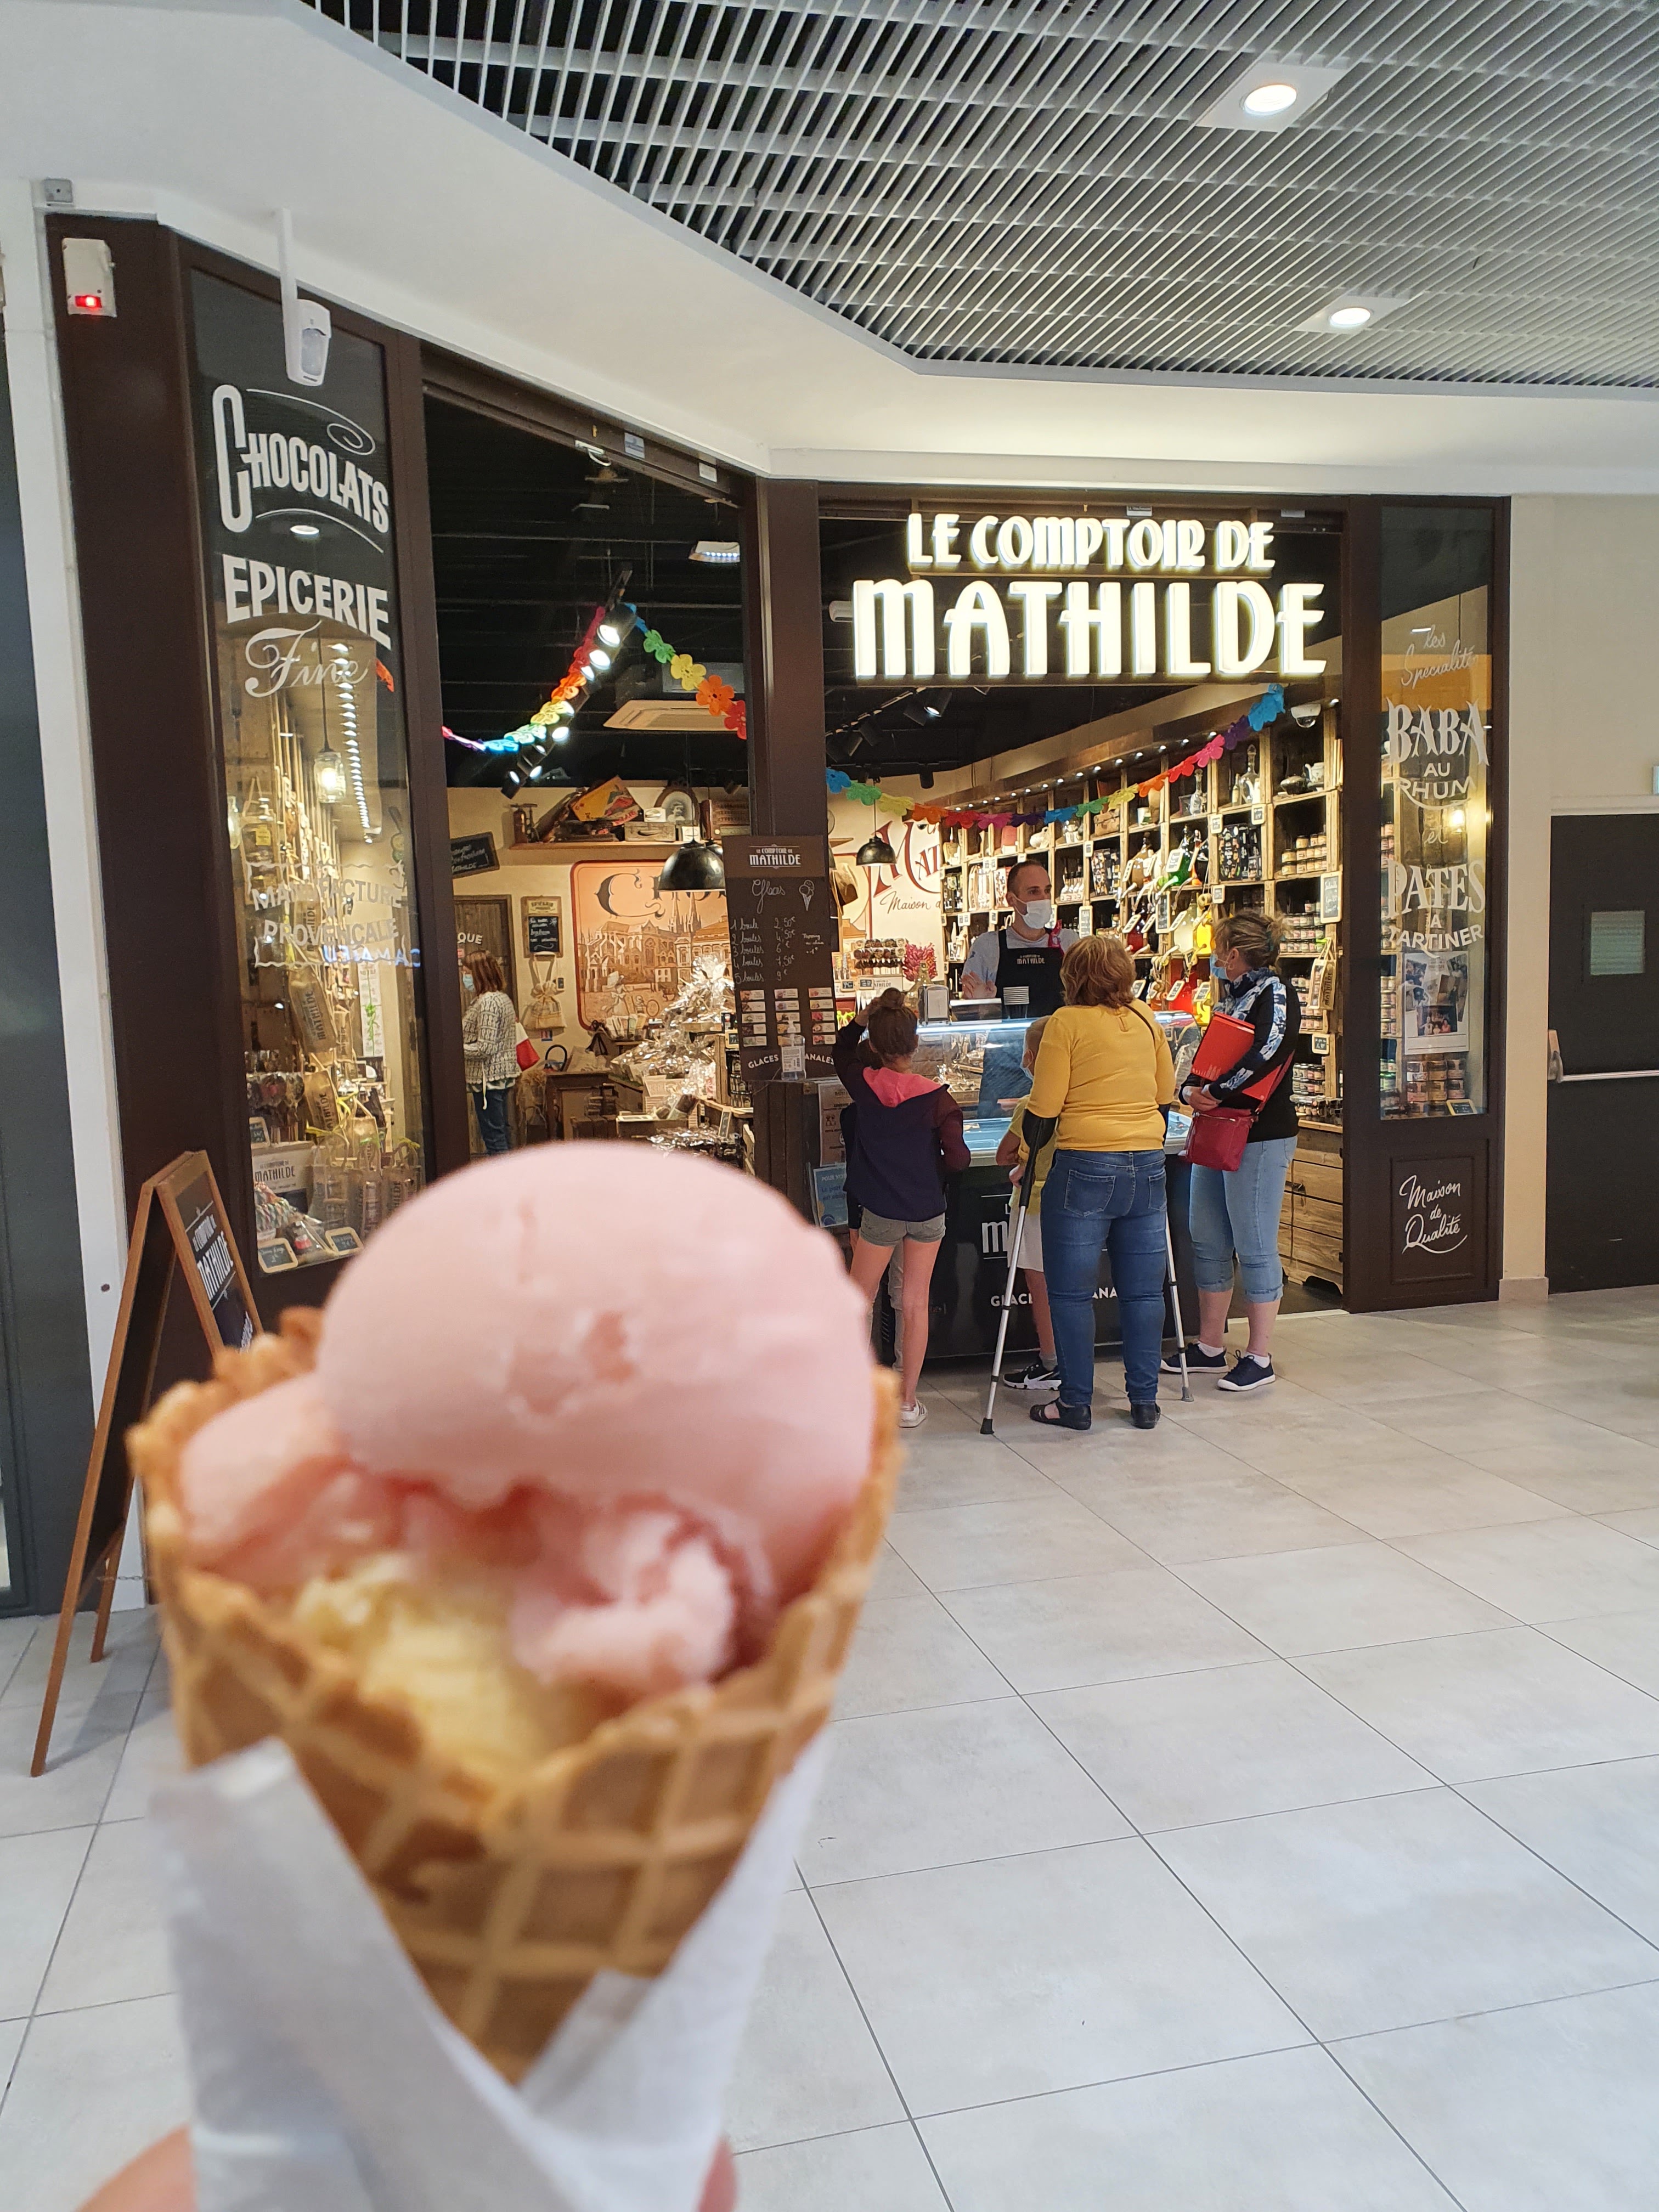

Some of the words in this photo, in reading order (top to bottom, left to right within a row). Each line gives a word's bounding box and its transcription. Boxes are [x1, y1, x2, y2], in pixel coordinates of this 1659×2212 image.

[213, 385, 389, 533] CHOCOLATS
[907, 513, 961, 564] LE
[971, 515, 1206, 568] COMPTOIR
[1217, 520, 1276, 568] DE
[222, 554, 391, 651] EPICERIE
[853, 579, 1327, 676] MATHILDE
[1386, 697, 1489, 766] BABA
[1424, 763, 1450, 777] AU
[1397, 775, 1478, 809] RHUM
[749, 854, 802, 865] MATHILDE
[880, 891, 932, 915] Maison
[1383, 858, 1486, 922] PATES
[1388, 924, 1483, 958] TARTINER
[748, 1054, 779, 1069] GLACES
[255, 1165, 296, 1182] MATHILDE
[1400, 1175, 1460, 1209] Maison
[1430, 1204, 1442, 1220] de
[1402, 1214, 1468, 1254] Qualité
